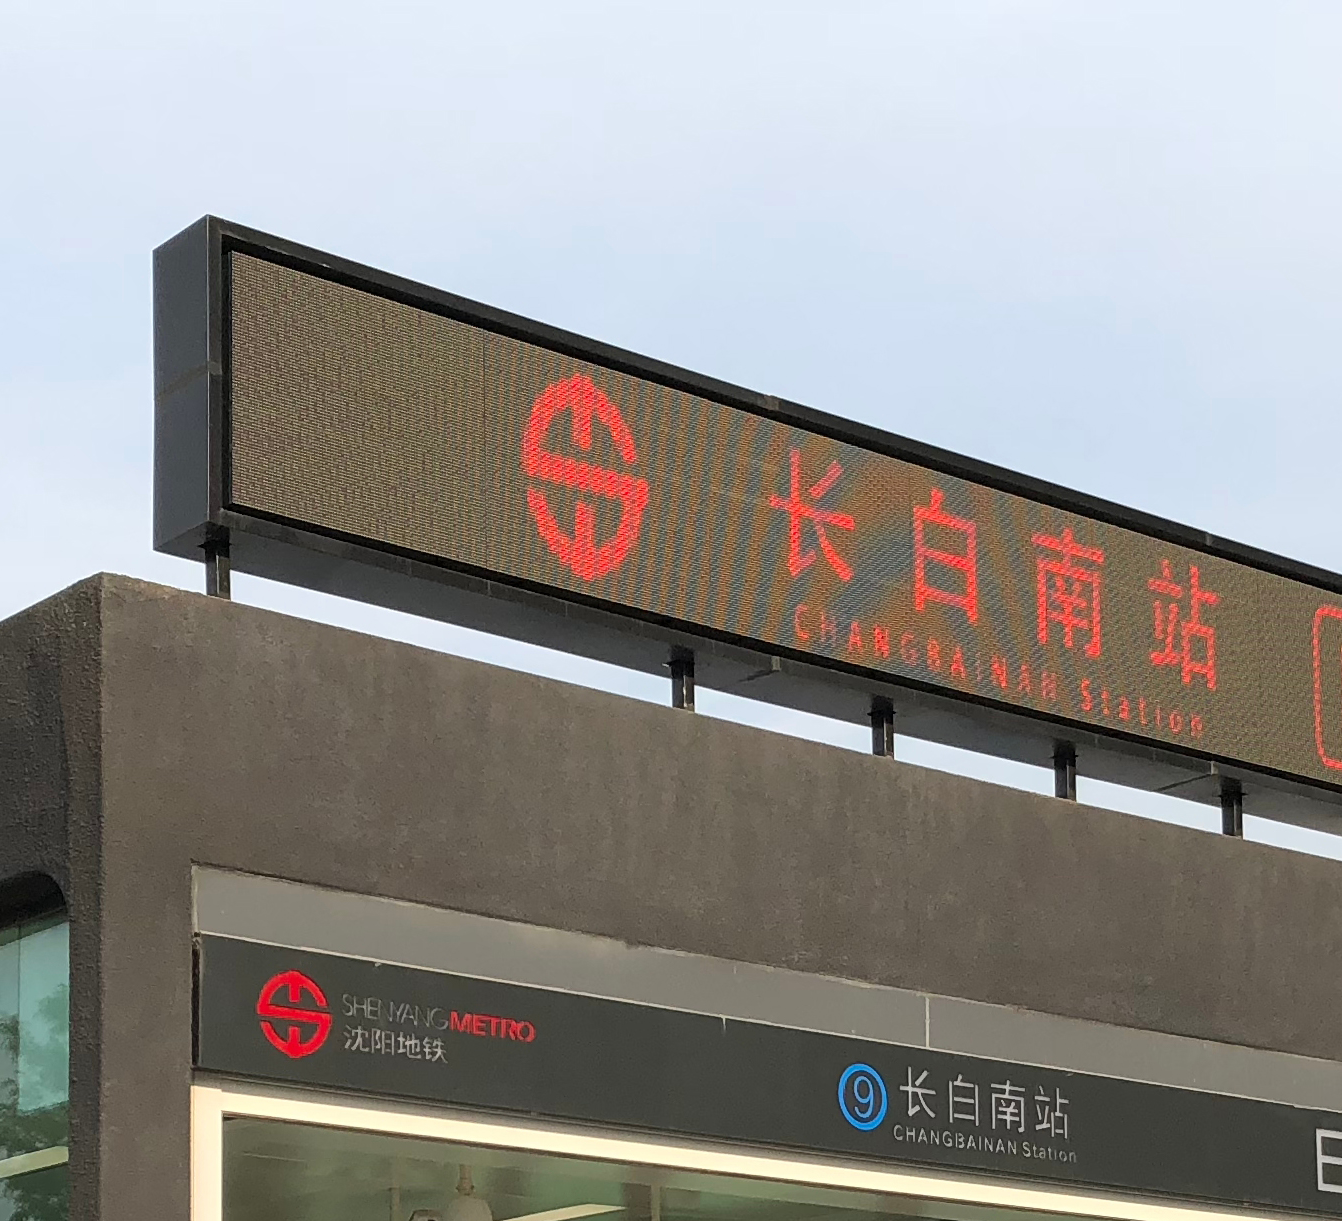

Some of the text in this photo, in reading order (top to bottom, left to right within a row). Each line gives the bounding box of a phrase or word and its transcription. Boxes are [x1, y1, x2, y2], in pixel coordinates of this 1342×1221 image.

[768, 448, 1221, 691] 长白南站
[794, 603, 1204, 738] CHANGBAINAN Station
[342, 1024, 449, 1064] 沈阳地铁
[899, 1066, 1070, 1140] 长白南站
[893, 1124, 1077, 1163] CHANGBAINAN Station
